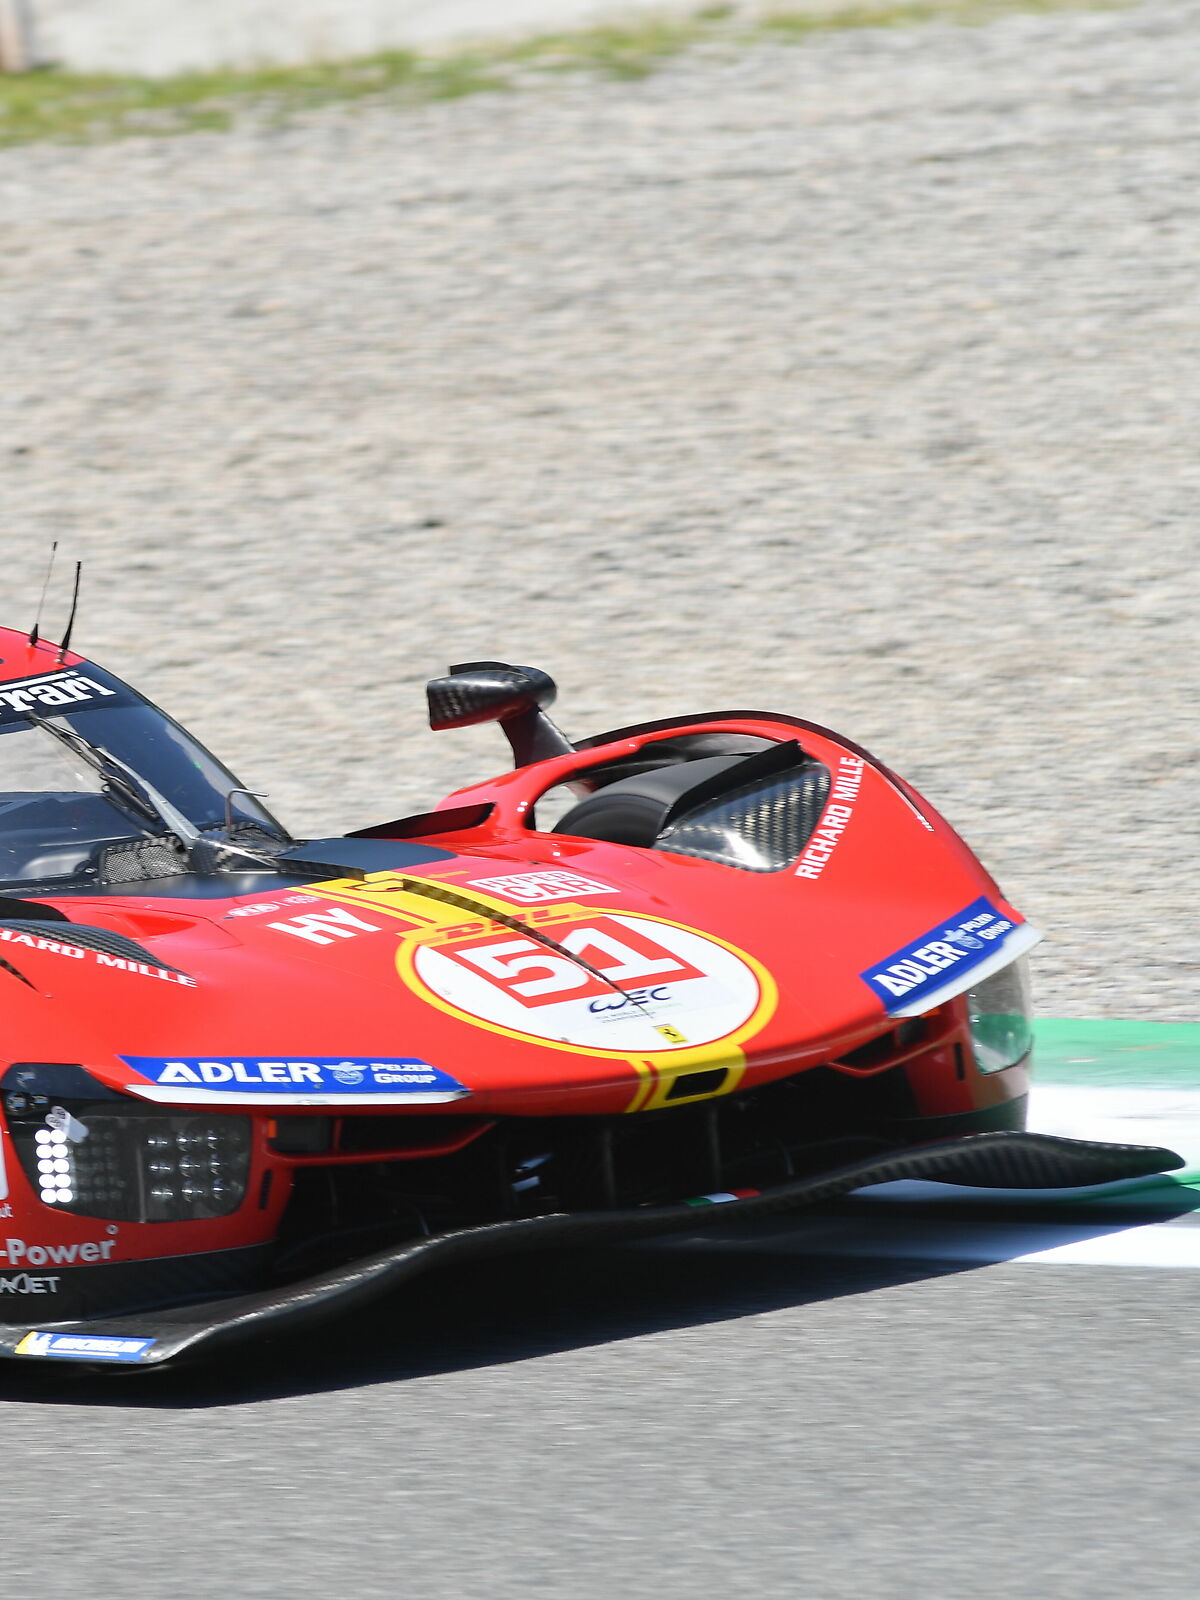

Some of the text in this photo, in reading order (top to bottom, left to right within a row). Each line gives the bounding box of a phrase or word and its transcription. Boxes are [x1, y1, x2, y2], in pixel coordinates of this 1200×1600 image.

[794, 757, 866, 880] RICHARD MILLE
[475, 872, 579, 889] HYPER
[501, 879, 609, 899] CAR
[266, 907, 383, 945] HY
[96, 952, 198, 988] MILLE
[453, 927, 687, 998] 51
[872, 941, 969, 997] ADLER
[589, 986, 672, 1013] WEC
[157, 1062, 325, 1083] ADLER
